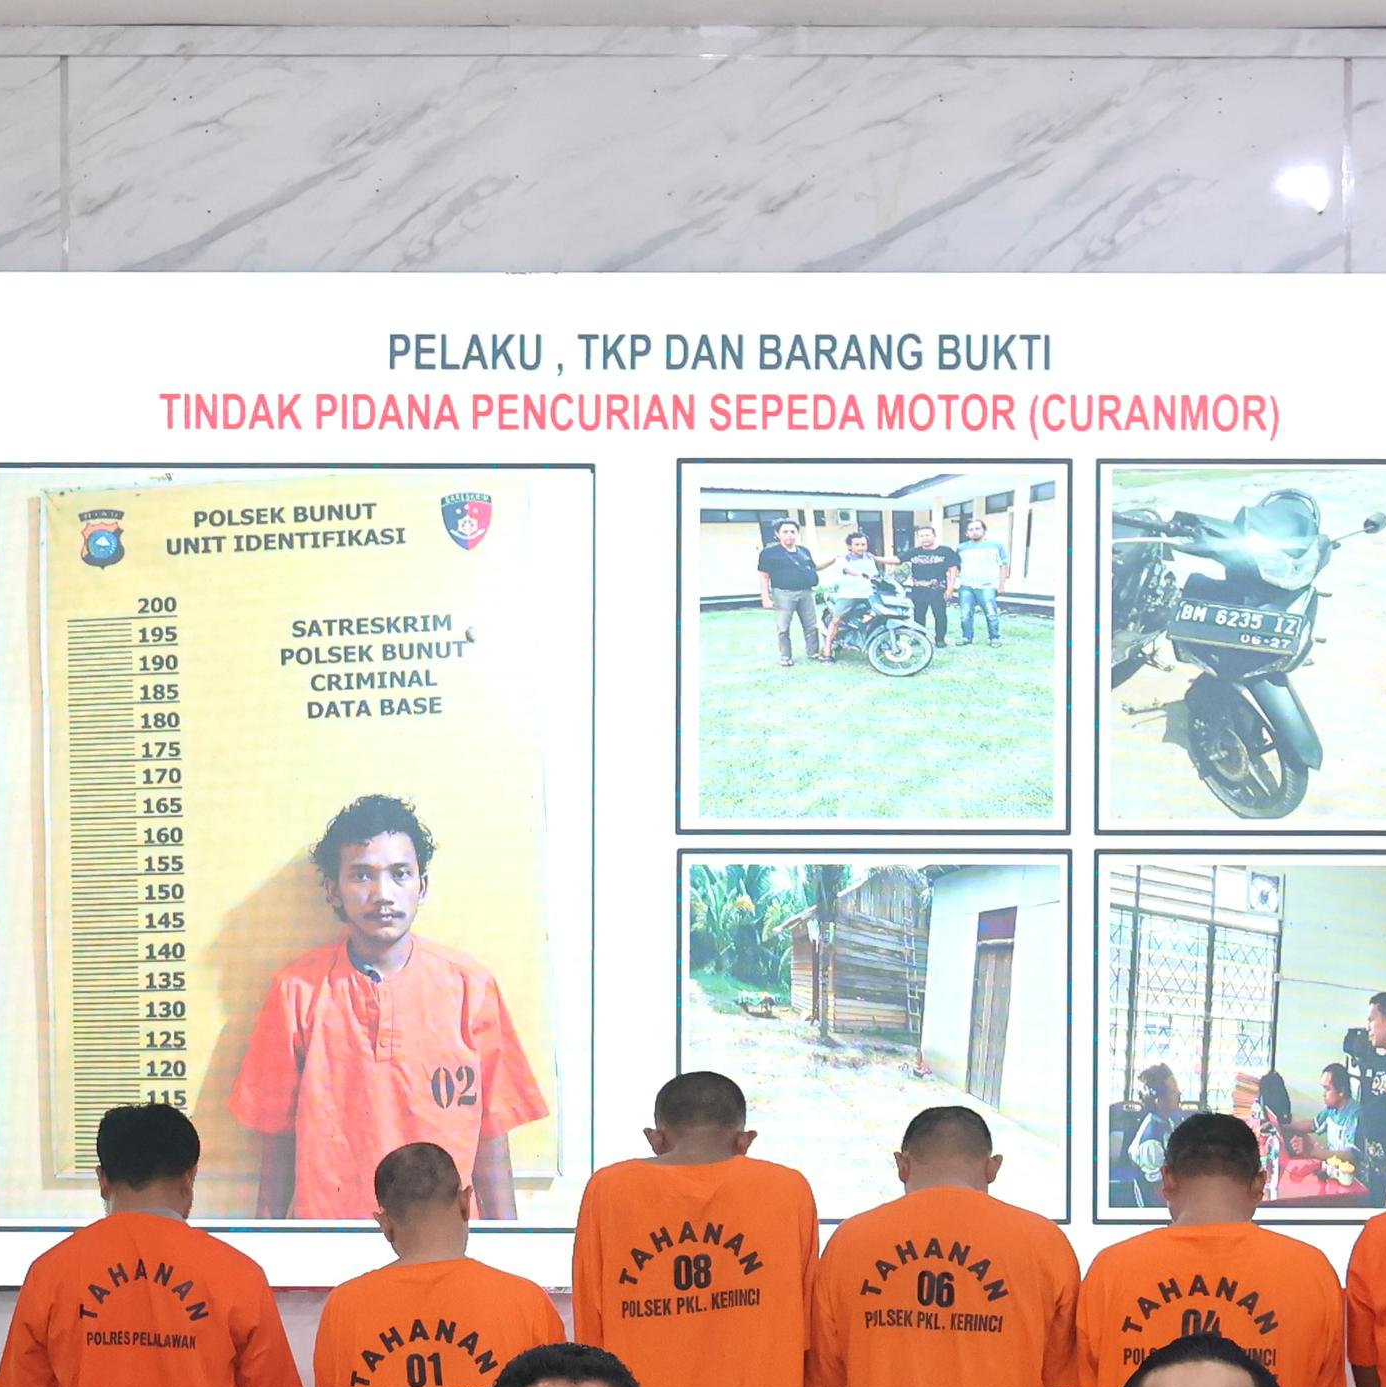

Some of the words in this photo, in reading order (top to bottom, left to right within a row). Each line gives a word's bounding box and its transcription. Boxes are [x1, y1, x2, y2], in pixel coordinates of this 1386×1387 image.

[389, 334, 543, 371] PELAKU
[578, 334, 651, 371] TKP
[665, 333, 744, 371] DAN
[759, 333, 923, 371] BARANG
[938, 333, 1051, 371] BUKTI
[159, 393, 302, 430] TINDAK
[315, 393, 459, 430] PIDANA
[471, 393, 694, 431] PENCURIAN
[710, 394, 865, 431] SEPEDA
[878, 394, 1016, 431] MOTOR
[1029, 393, 1280, 440] (CURANMOR)
[194, 506, 285, 528] POLSEK
[293, 503, 377, 523] BUNUT
[166, 535, 226, 556] UNIT
[233, 527, 407, 553] IDENTIFIKASI
[137, 597, 177, 614] 200
[291, 614, 452, 638] SATRESKRIM
[1181, 604, 1208, 622] BM
[1215, 609, 1264, 630] 6235
[1274, 616, 1298, 635] IZ
[138, 627, 178, 643] 195
[281, 645, 373, 666] POLSEK
[382, 639, 468, 660] BUNUT
[139, 655, 179, 672] 190
[310, 670, 437, 692] CRIMINAL
[139, 684, 179, 701] 185
[307, 700, 375, 719] DATA
[380, 697, 442, 716] BASE
[140, 712, 180, 729] 180
[140, 741, 181, 758] 175
[141, 767, 181, 785] 170
[142, 797, 182, 815] 165
[143, 827, 183, 844] 160
[144, 855, 184, 872] 155
[144, 883, 184, 901] 150
[144, 911, 185, 929] 145
[145, 942, 185, 960] 140
[145, 971, 185, 989] 135
[145, 1001, 186, 1019] 130
[145, 1031, 186, 1049] 125
[146, 1060, 186, 1077] 120
[431, 1065, 477, 1109] 02
[147, 1090, 187, 1106] 115
[619, 1221, 763, 1288] TAHANAN
[673, 1254, 712, 1291] 08
[860, 1237, 1010, 1303] TAHANAN
[80, 1257, 209, 1322] TAHANAN
[917, 1270, 955, 1307] 06
[621, 1297, 672, 1319] POLSEK
[676, 1294, 708, 1315] PKL.
[711, 1288, 761, 1310] KERINCI
[1121, 1274, 1279, 1337] TAHANAN
[916, 1311, 946, 1331] PKL.
[950, 1311, 1003, 1333] KERINCI
[1181, 1309, 1222, 1338] 04
[87, 1331, 131, 1346] POLRES
